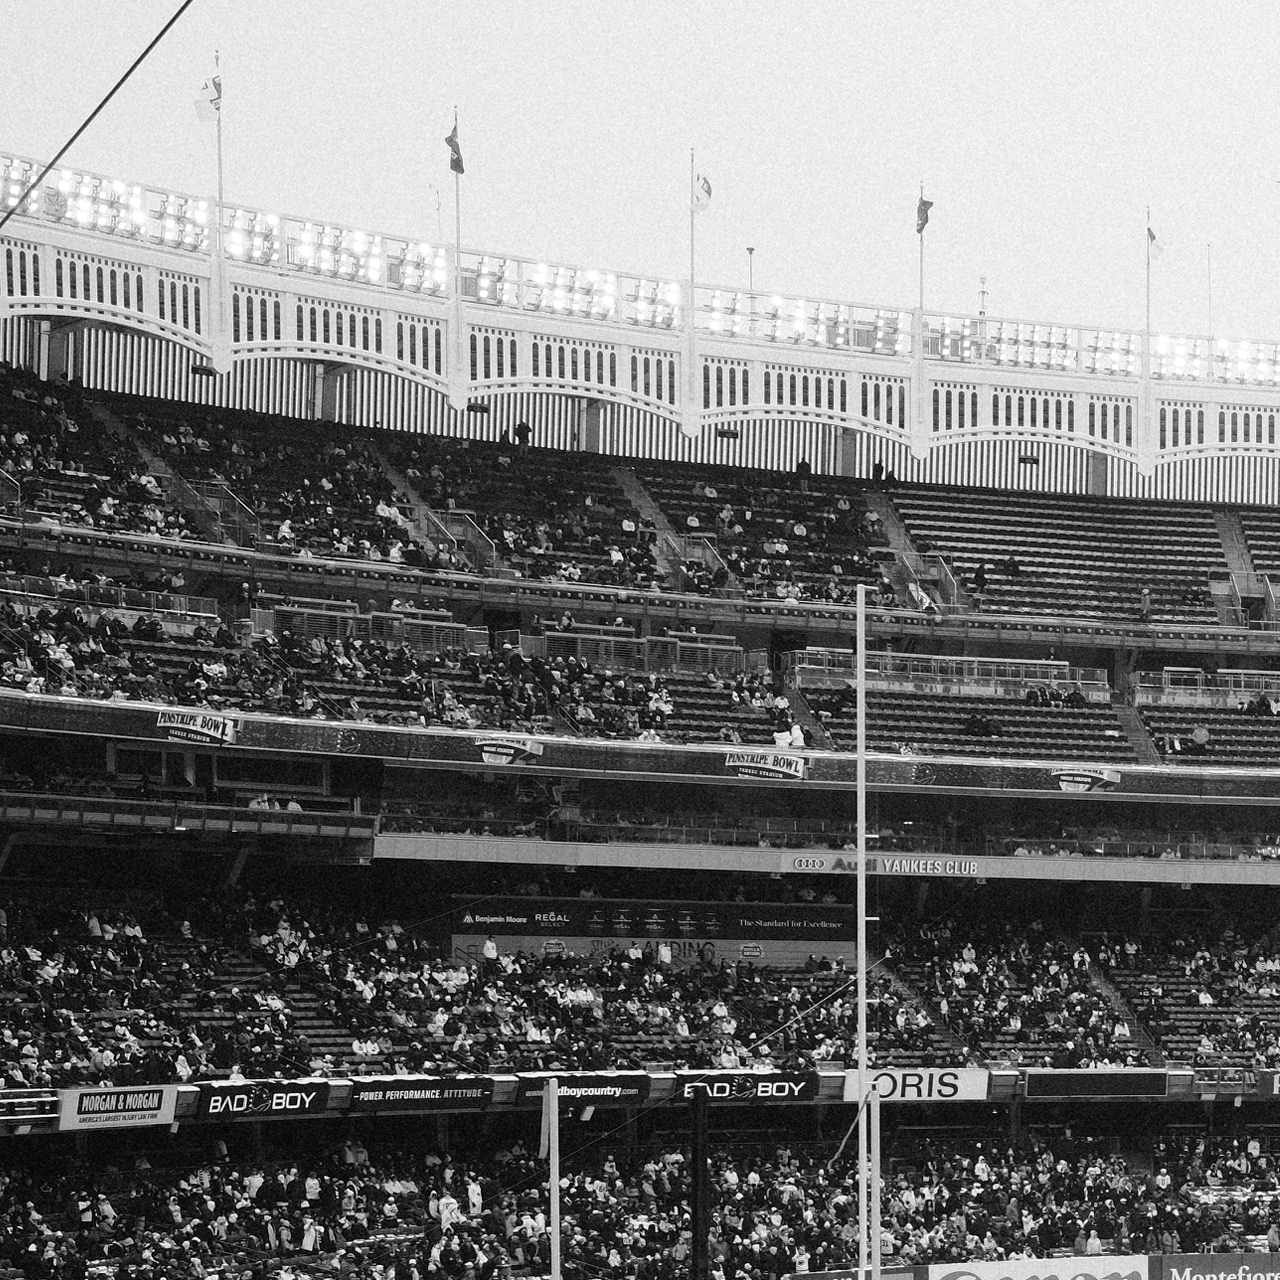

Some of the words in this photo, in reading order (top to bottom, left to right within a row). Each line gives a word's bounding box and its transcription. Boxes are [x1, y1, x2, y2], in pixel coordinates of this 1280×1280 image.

[159, 711, 199, 728] PINSTRIPE
[201, 718, 230, 737] BOWL
[727, 752, 770, 767] PINSTRIPE
[772, 756, 800, 773] BOWL
[882, 859, 942, 874] YANKEES
[946, 860, 978, 875] CLUB
[475, 914, 504, 924] Benjamin
[506, 916, 527, 924] Moore
[535, 912, 570, 923] REGAL
[739, 919, 754, 928] The
[755, 919, 789, 928] Standard
[790, 920, 802, 928] for
[803, 920, 843, 929] Excellence
[757, 1081, 806, 1098] BOY
[873, 1072, 959, 1099] ORIS
[82, 1095, 117, 1112] MORGAN
[118, 1094, 125, 1110] &
[125, 1093, 160, 1110] MORGAN
[209, 1095, 248, 1113] BAD
[271, 1092, 317, 1110] BOY
